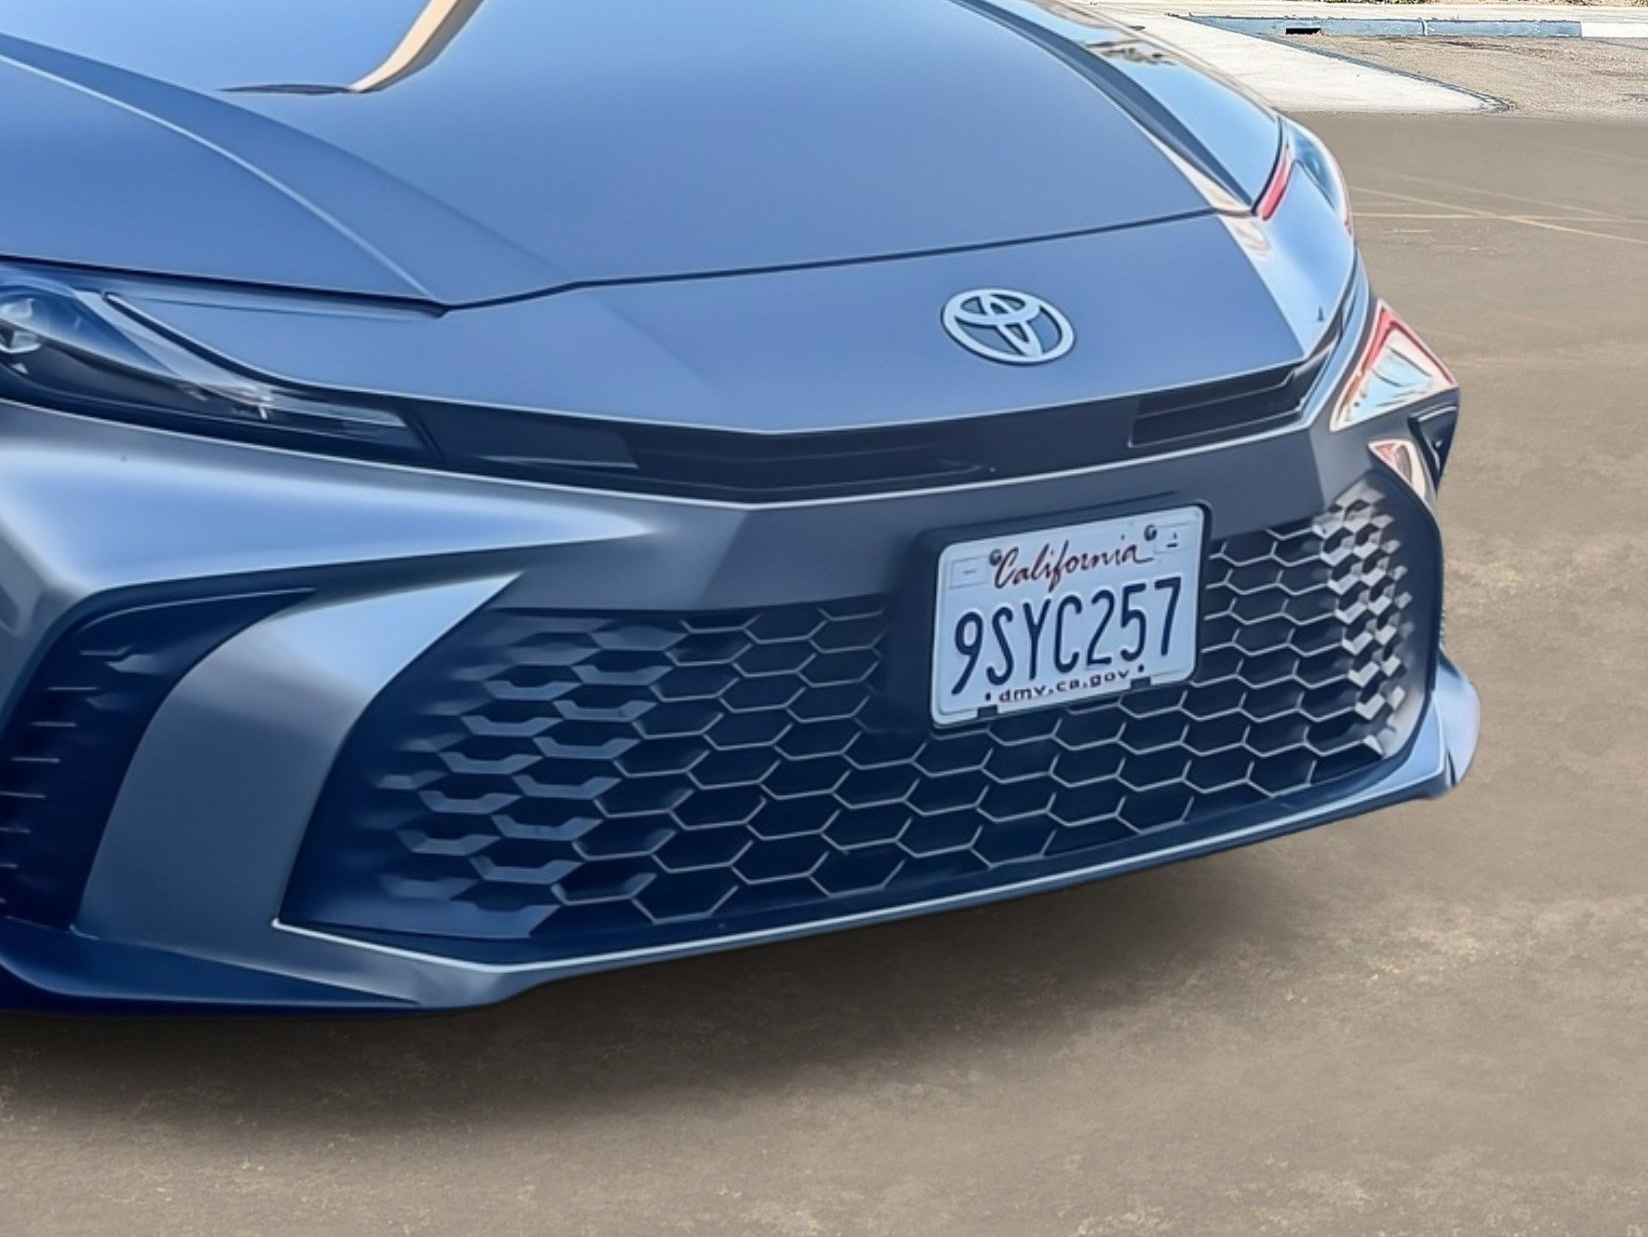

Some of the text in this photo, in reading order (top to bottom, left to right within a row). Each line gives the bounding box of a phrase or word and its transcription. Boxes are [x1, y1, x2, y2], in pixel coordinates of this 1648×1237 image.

[993, 540, 1154, 593] California
[951, 576, 1182, 696] 9SYC257
[998, 668, 1130, 704] dmv.ca.gov
